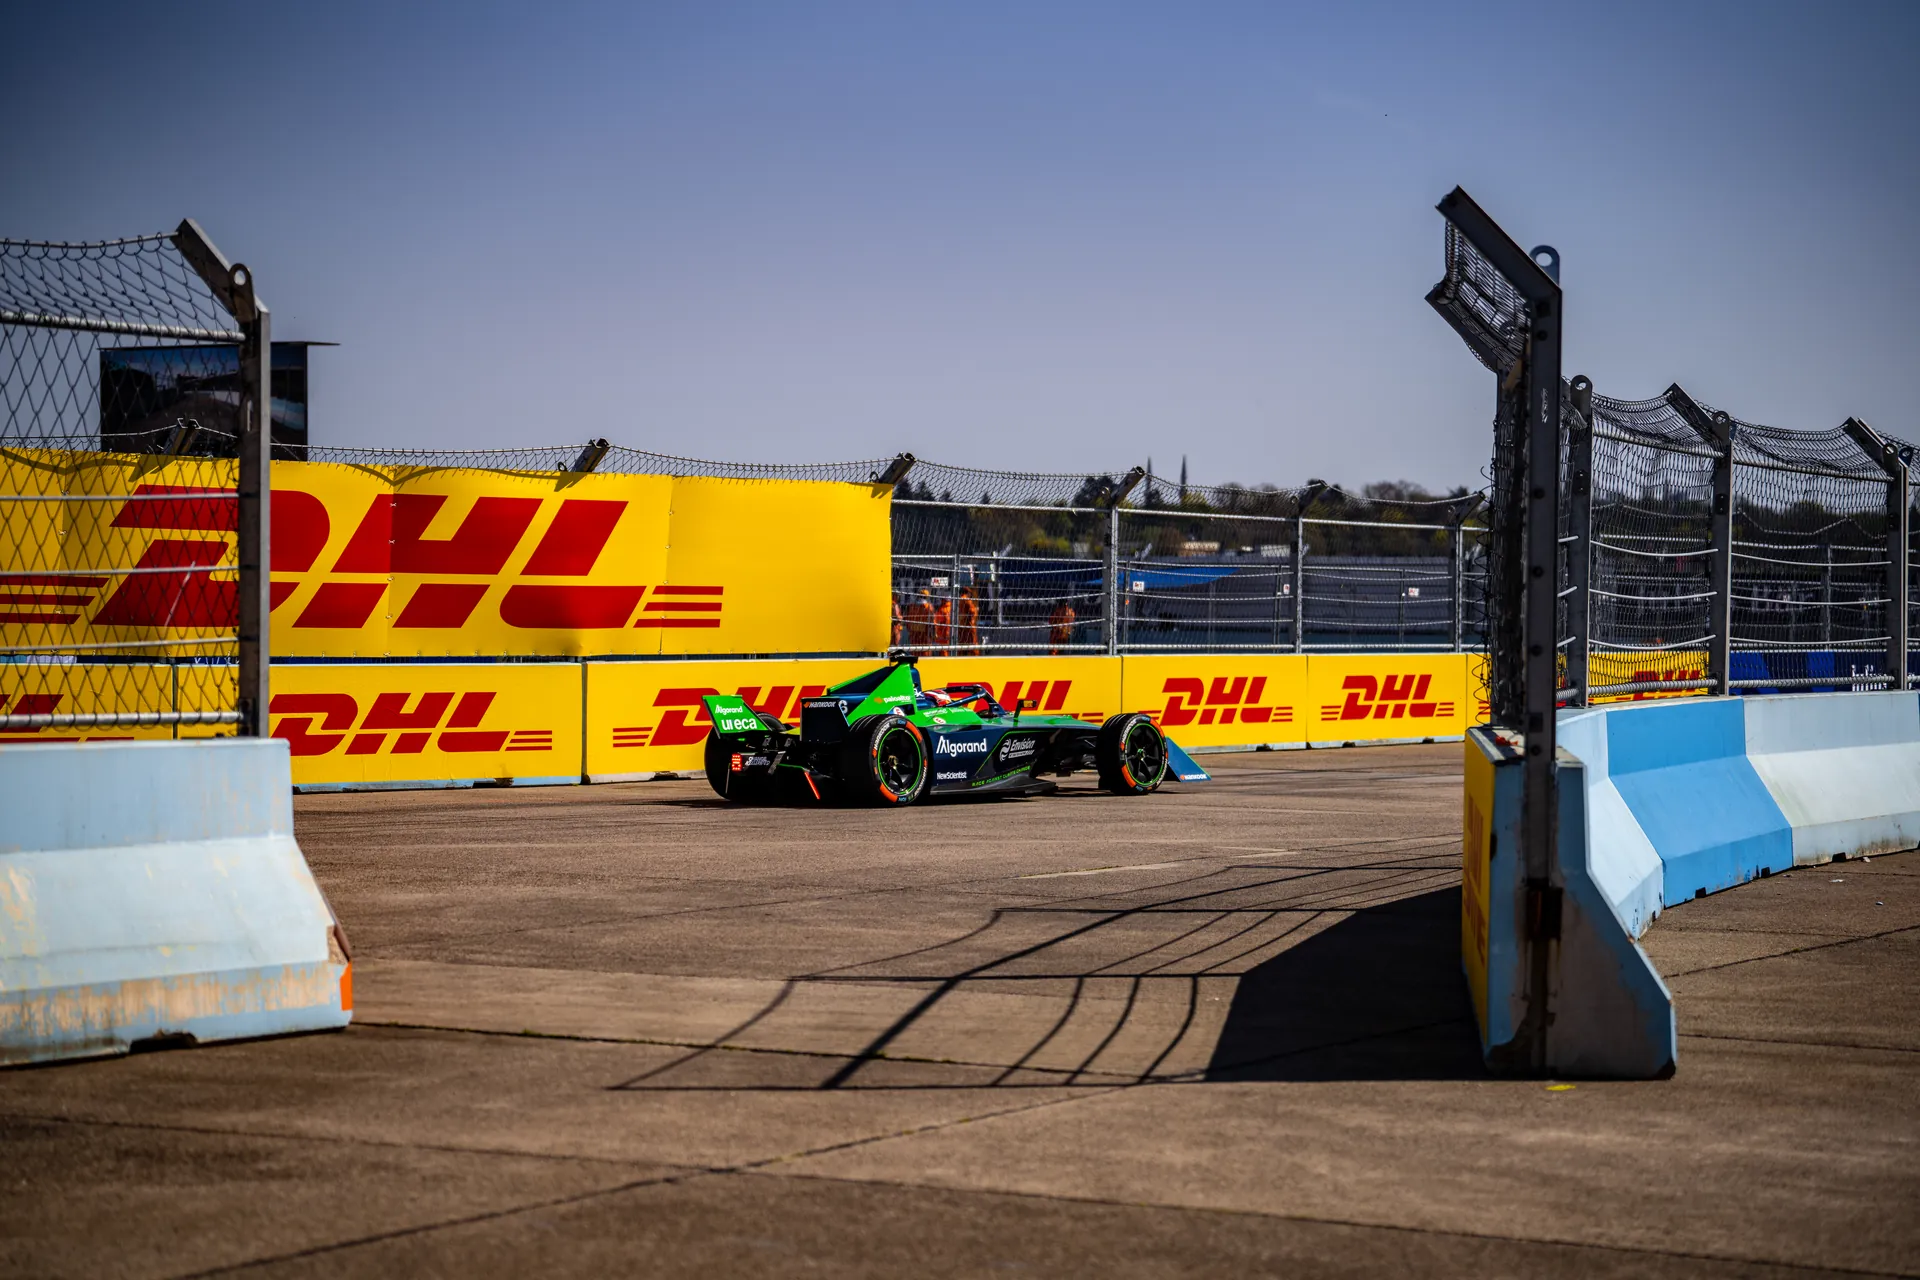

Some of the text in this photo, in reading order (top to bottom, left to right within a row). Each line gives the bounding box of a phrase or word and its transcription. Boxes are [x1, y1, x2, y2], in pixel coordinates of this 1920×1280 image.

[92, 484, 646, 629] DHL
[715, 704, 743, 715] Algorand
[1160, 676, 1273, 726] DHL
[1339, 674, 1438, 721] DHL
[270, 691, 509, 756] DHL
[936, 735, 988, 757] Algorand
[1010, 738, 1036, 751] Envision
